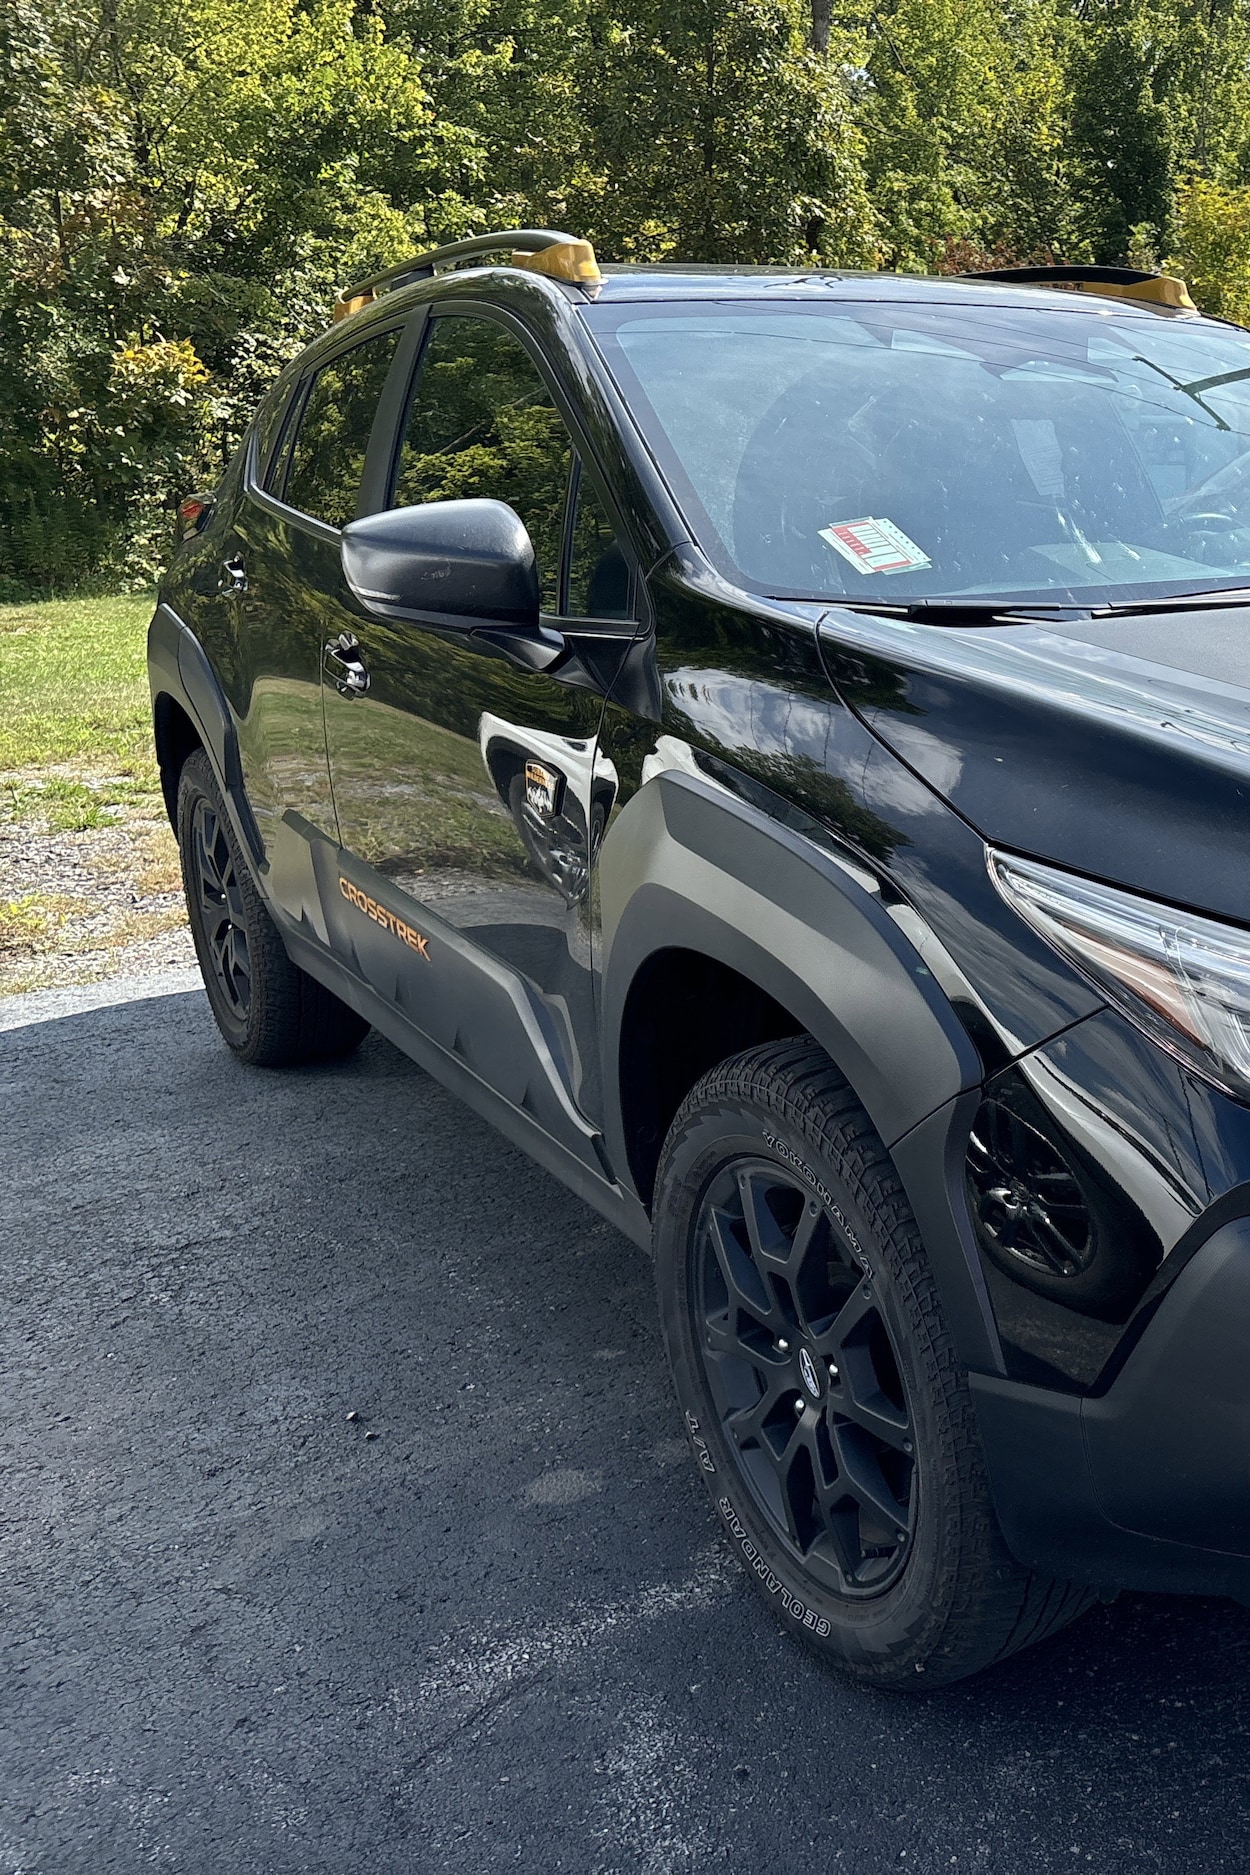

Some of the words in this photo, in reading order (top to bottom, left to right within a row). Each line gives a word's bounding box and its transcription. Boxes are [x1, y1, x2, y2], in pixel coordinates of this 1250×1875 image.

[339, 877, 431, 962] CROSSTREK
[762, 1128, 875, 1280] YOKOHAMA
[718, 1496, 832, 1638] GEOLANDAR
